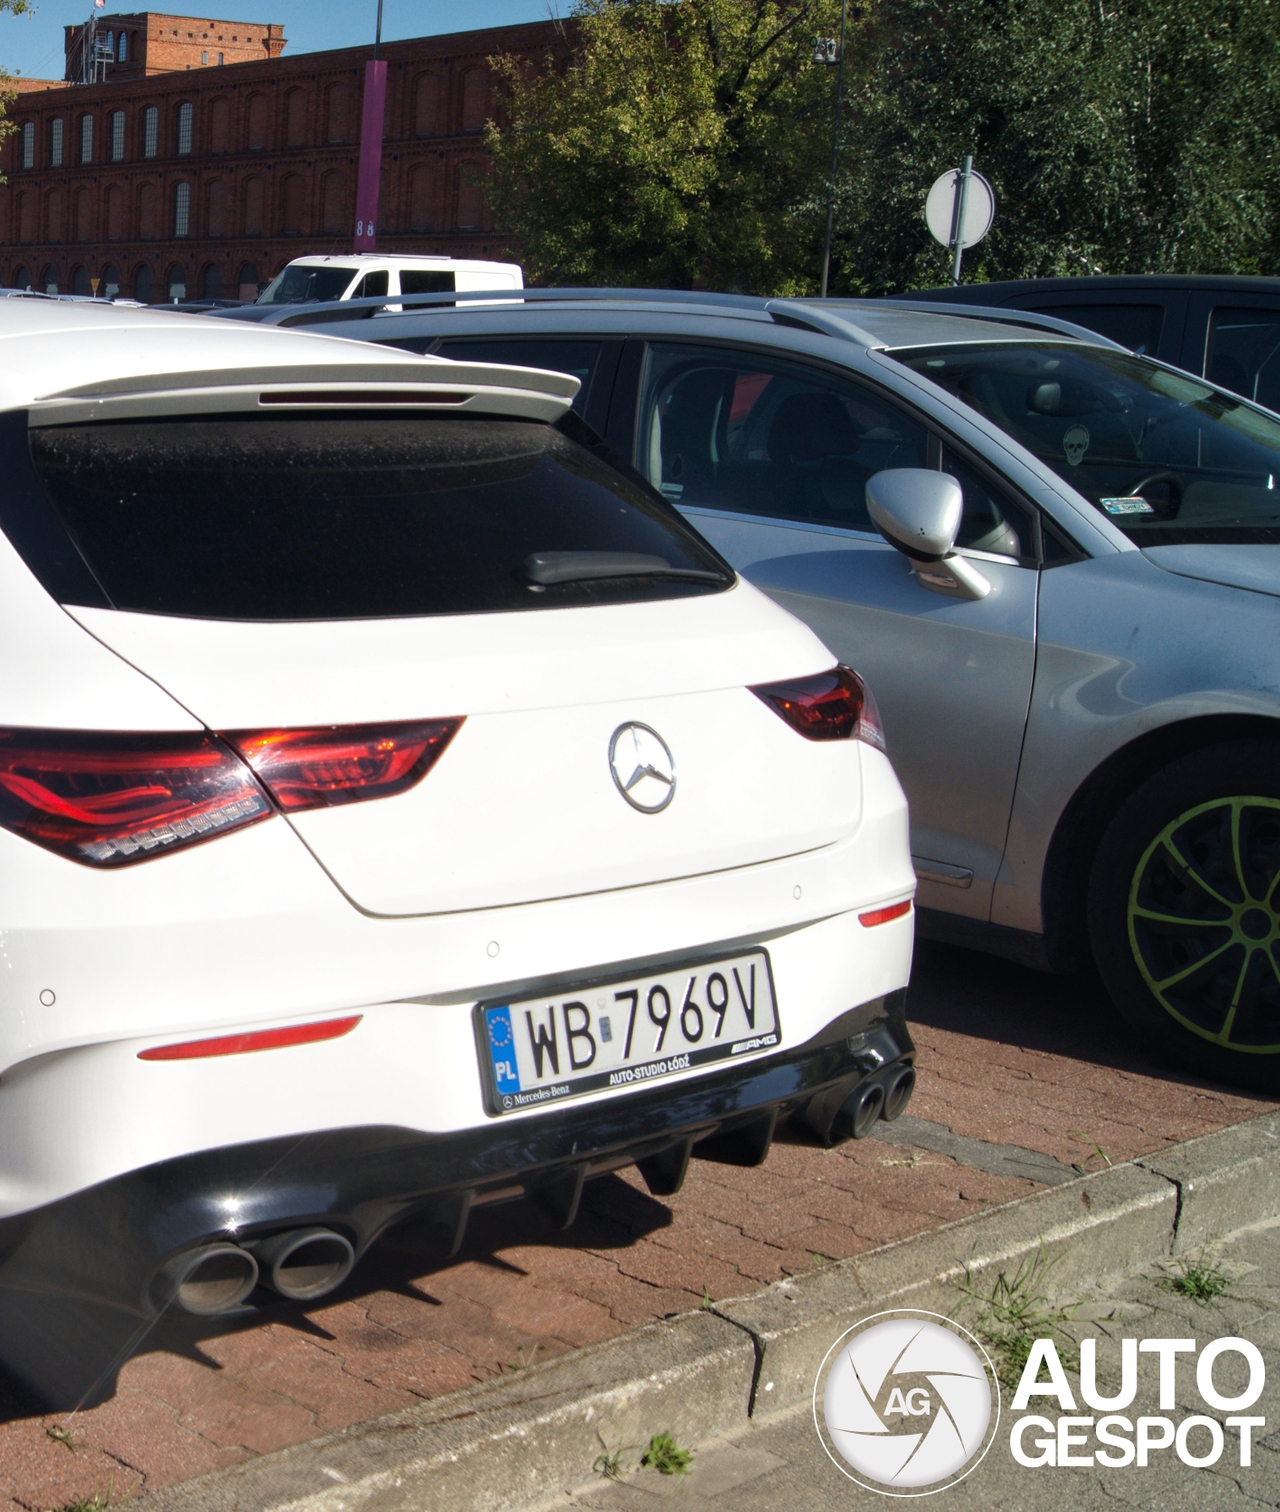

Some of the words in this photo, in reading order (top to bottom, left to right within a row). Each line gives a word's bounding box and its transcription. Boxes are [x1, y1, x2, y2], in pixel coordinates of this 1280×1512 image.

[524, 1001, 597, 1080] WB
[613, 963, 757, 1061] 7969V
[746, 1034, 778, 1050] AMG
[495, 1060, 517, 1083] PL
[609, 1061, 667, 1086] AUTO-STUDIO
[667, 1053, 691, 1072] ŁÓDŹ
[514, 1084, 571, 1106] Mercedes-Benz
